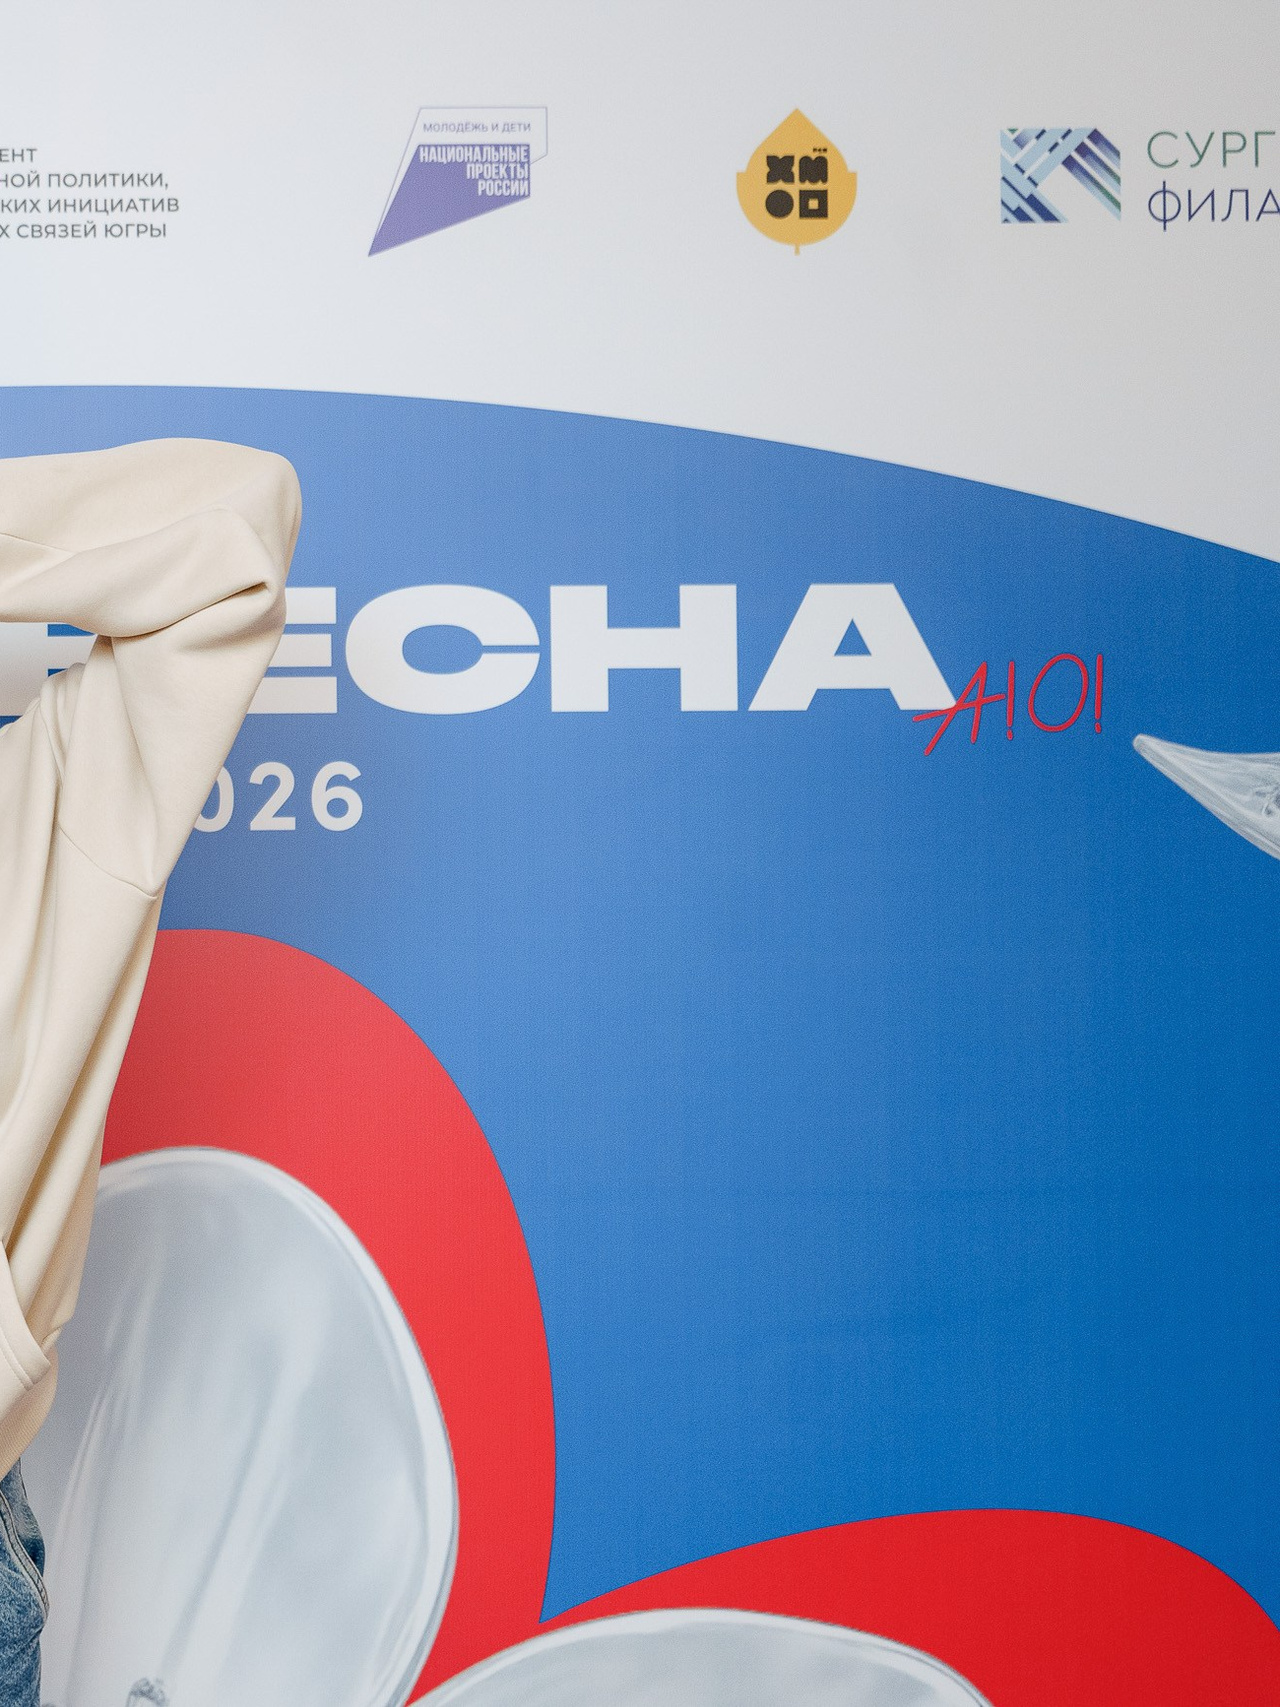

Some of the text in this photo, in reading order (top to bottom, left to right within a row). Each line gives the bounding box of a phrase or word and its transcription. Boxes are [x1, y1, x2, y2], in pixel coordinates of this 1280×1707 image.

[423, 122, 531, 133] МОЛОДЁЖЬ И ДЕТИ
[420, 145, 528, 164] НАЦИОНАЛЬНЫЕ
[1147, 131, 1276, 169] СУРГ
[466, 163, 528, 179] ПРОЕКТЫ
[48, 172, 170, 190] ПОЛИТИКИ,
[477, 180, 529, 196] РОССИИ
[48, 198, 180, 214] ИНИЦИАТИВ
[1148, 180, 1280, 232] ФИЛА
[17, 221, 97, 239] СВЯЗЕЙ
[104, 223, 167, 238] ЮГРЫ
[193, 760, 363, 832] 026
